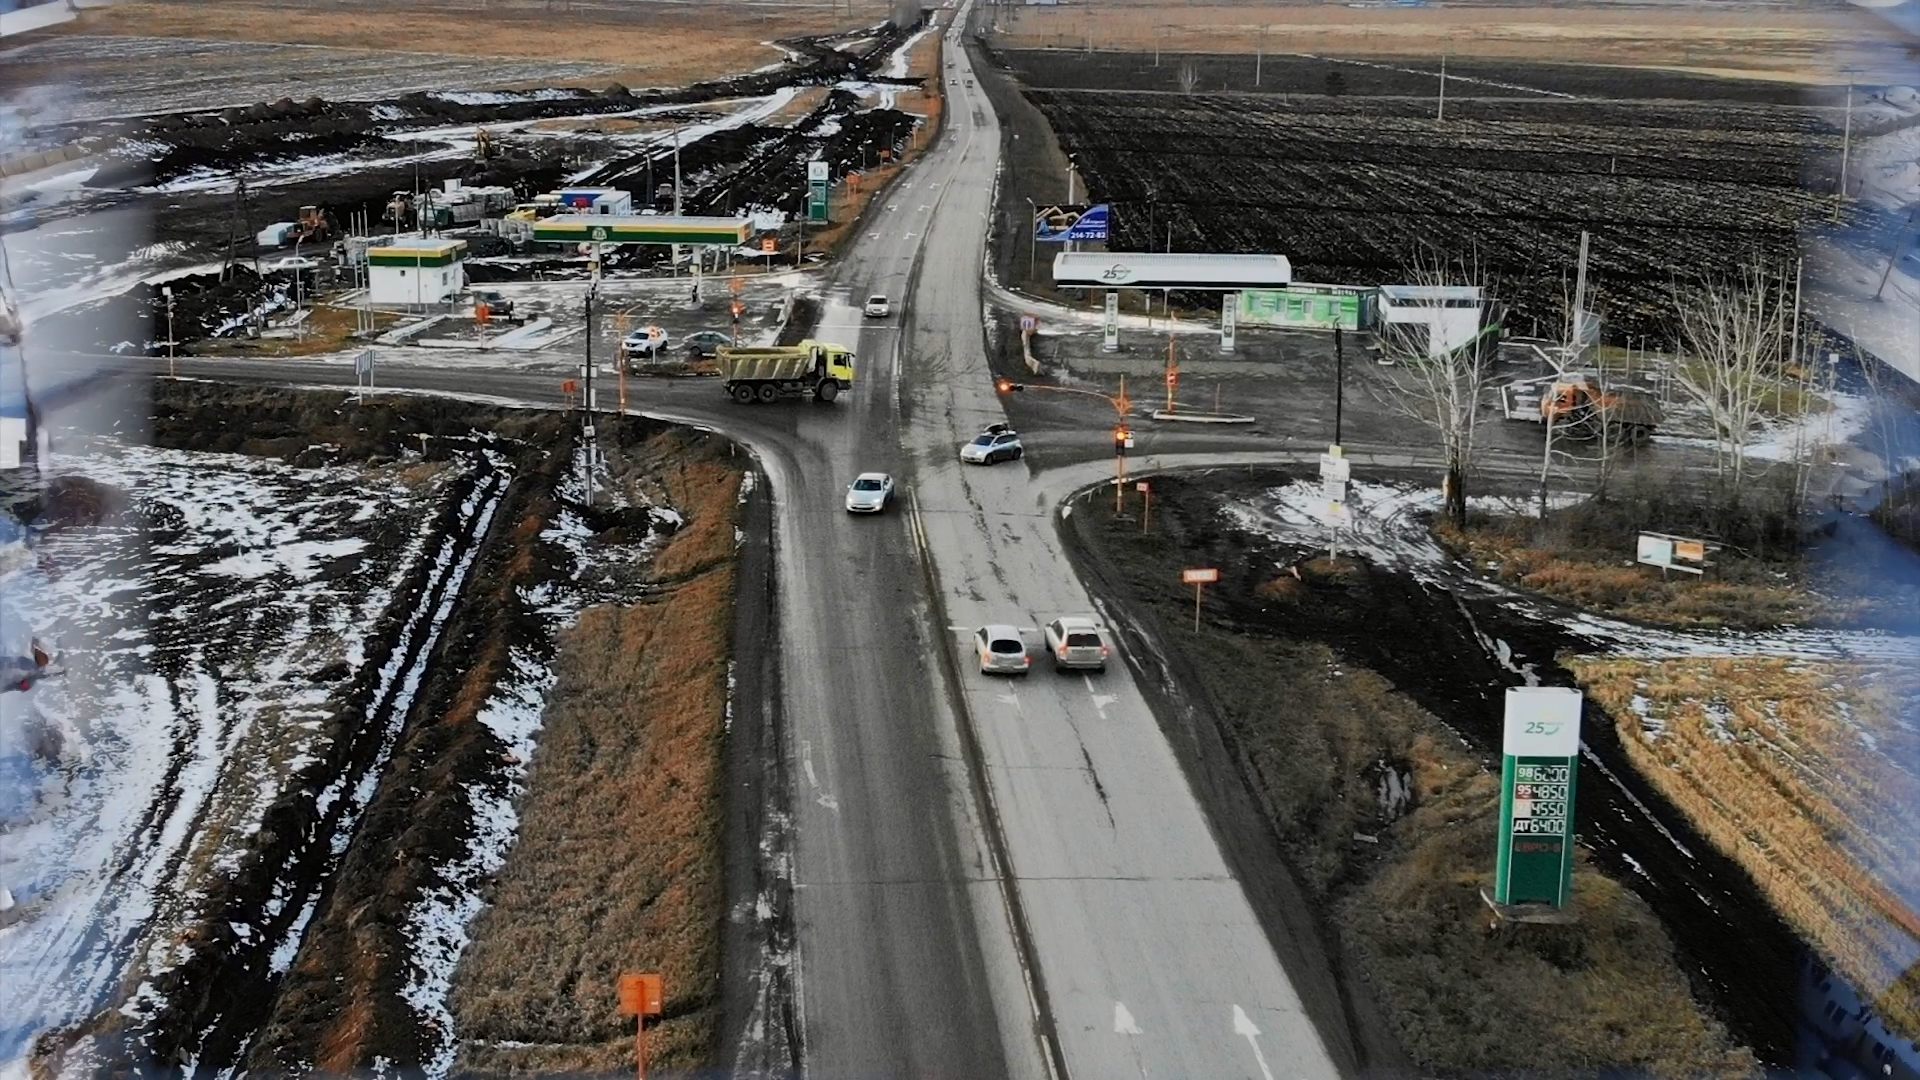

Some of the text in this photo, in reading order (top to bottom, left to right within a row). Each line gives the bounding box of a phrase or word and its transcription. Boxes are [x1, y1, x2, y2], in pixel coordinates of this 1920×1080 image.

[1102, 269, 1117, 279] 25
[1525, 721, 1545, 734] 25
[1518, 767, 1534, 778] 98
[1517, 784, 1532, 795] 95
[1513, 820, 1530, 832] ДТ
